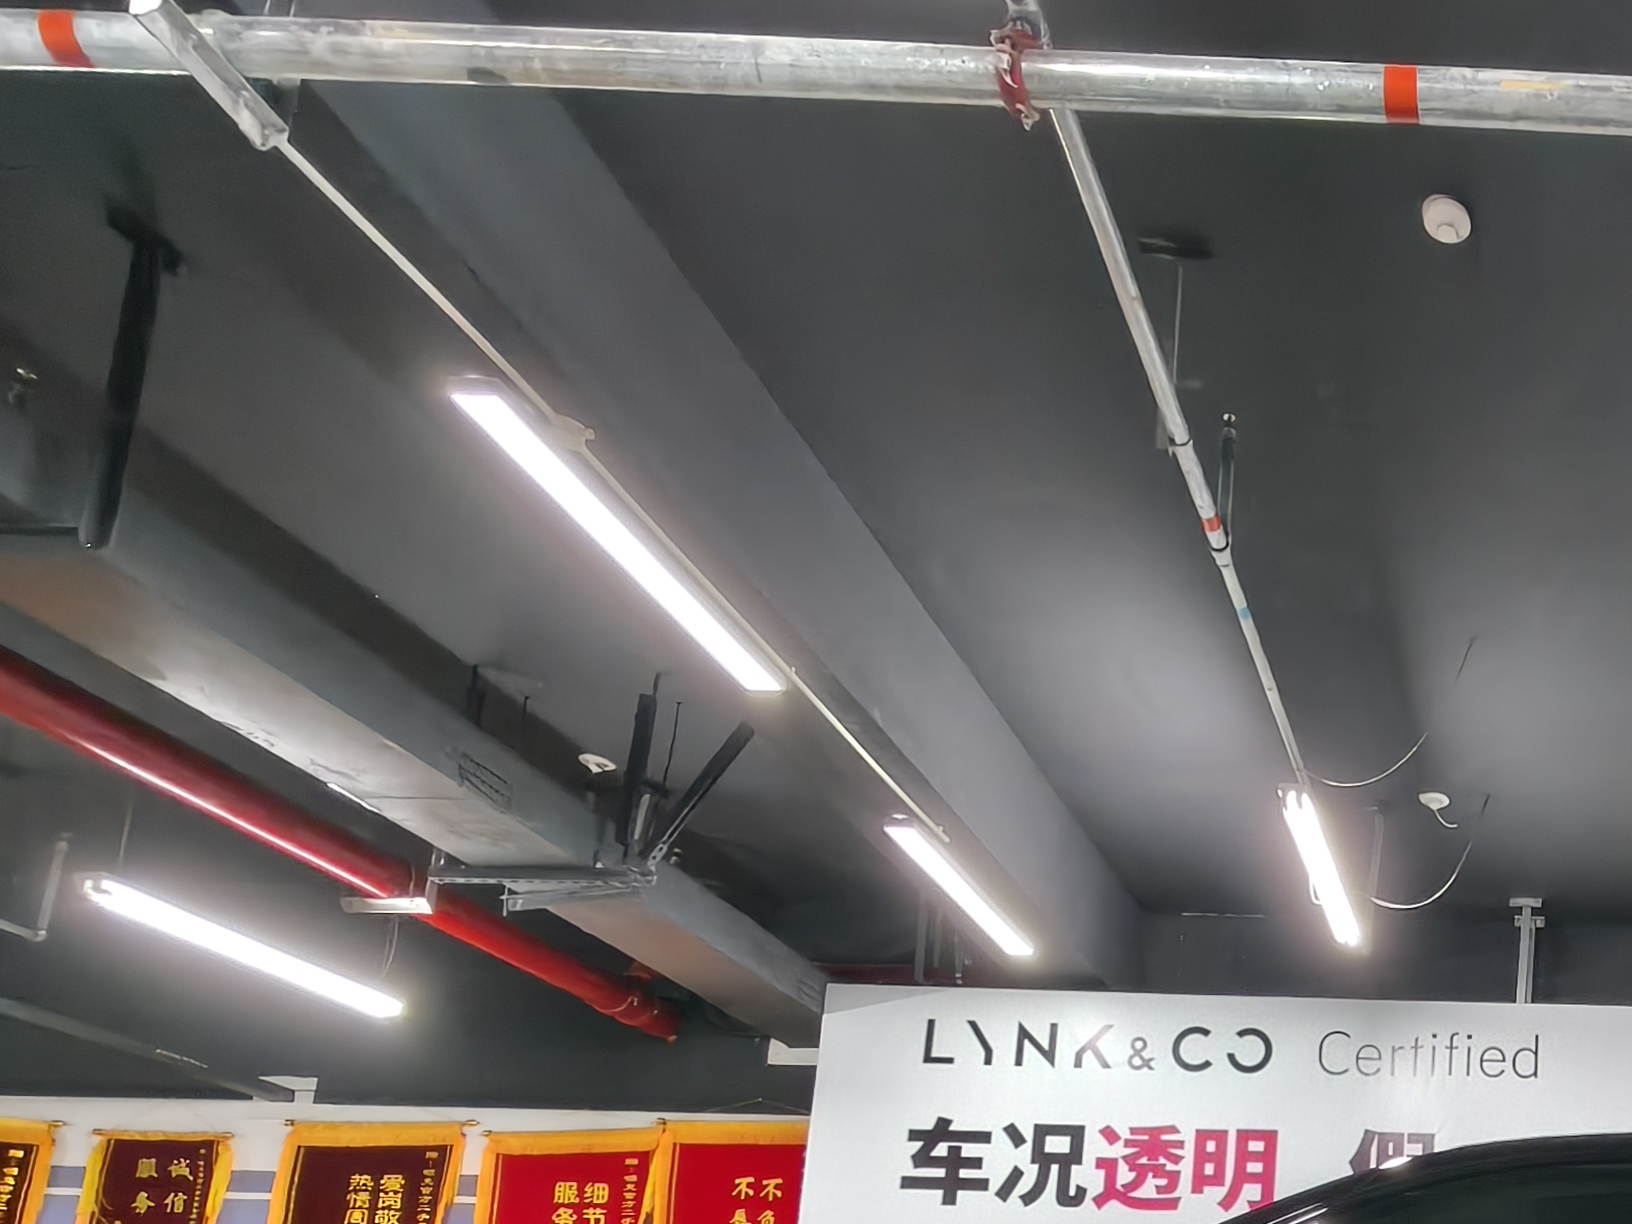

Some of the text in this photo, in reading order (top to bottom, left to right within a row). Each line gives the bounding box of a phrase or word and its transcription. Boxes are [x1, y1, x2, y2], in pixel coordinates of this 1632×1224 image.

[1317, 1029, 1541, 1080] Certified
[899, 1116, 1281, 1211] 车况透明
